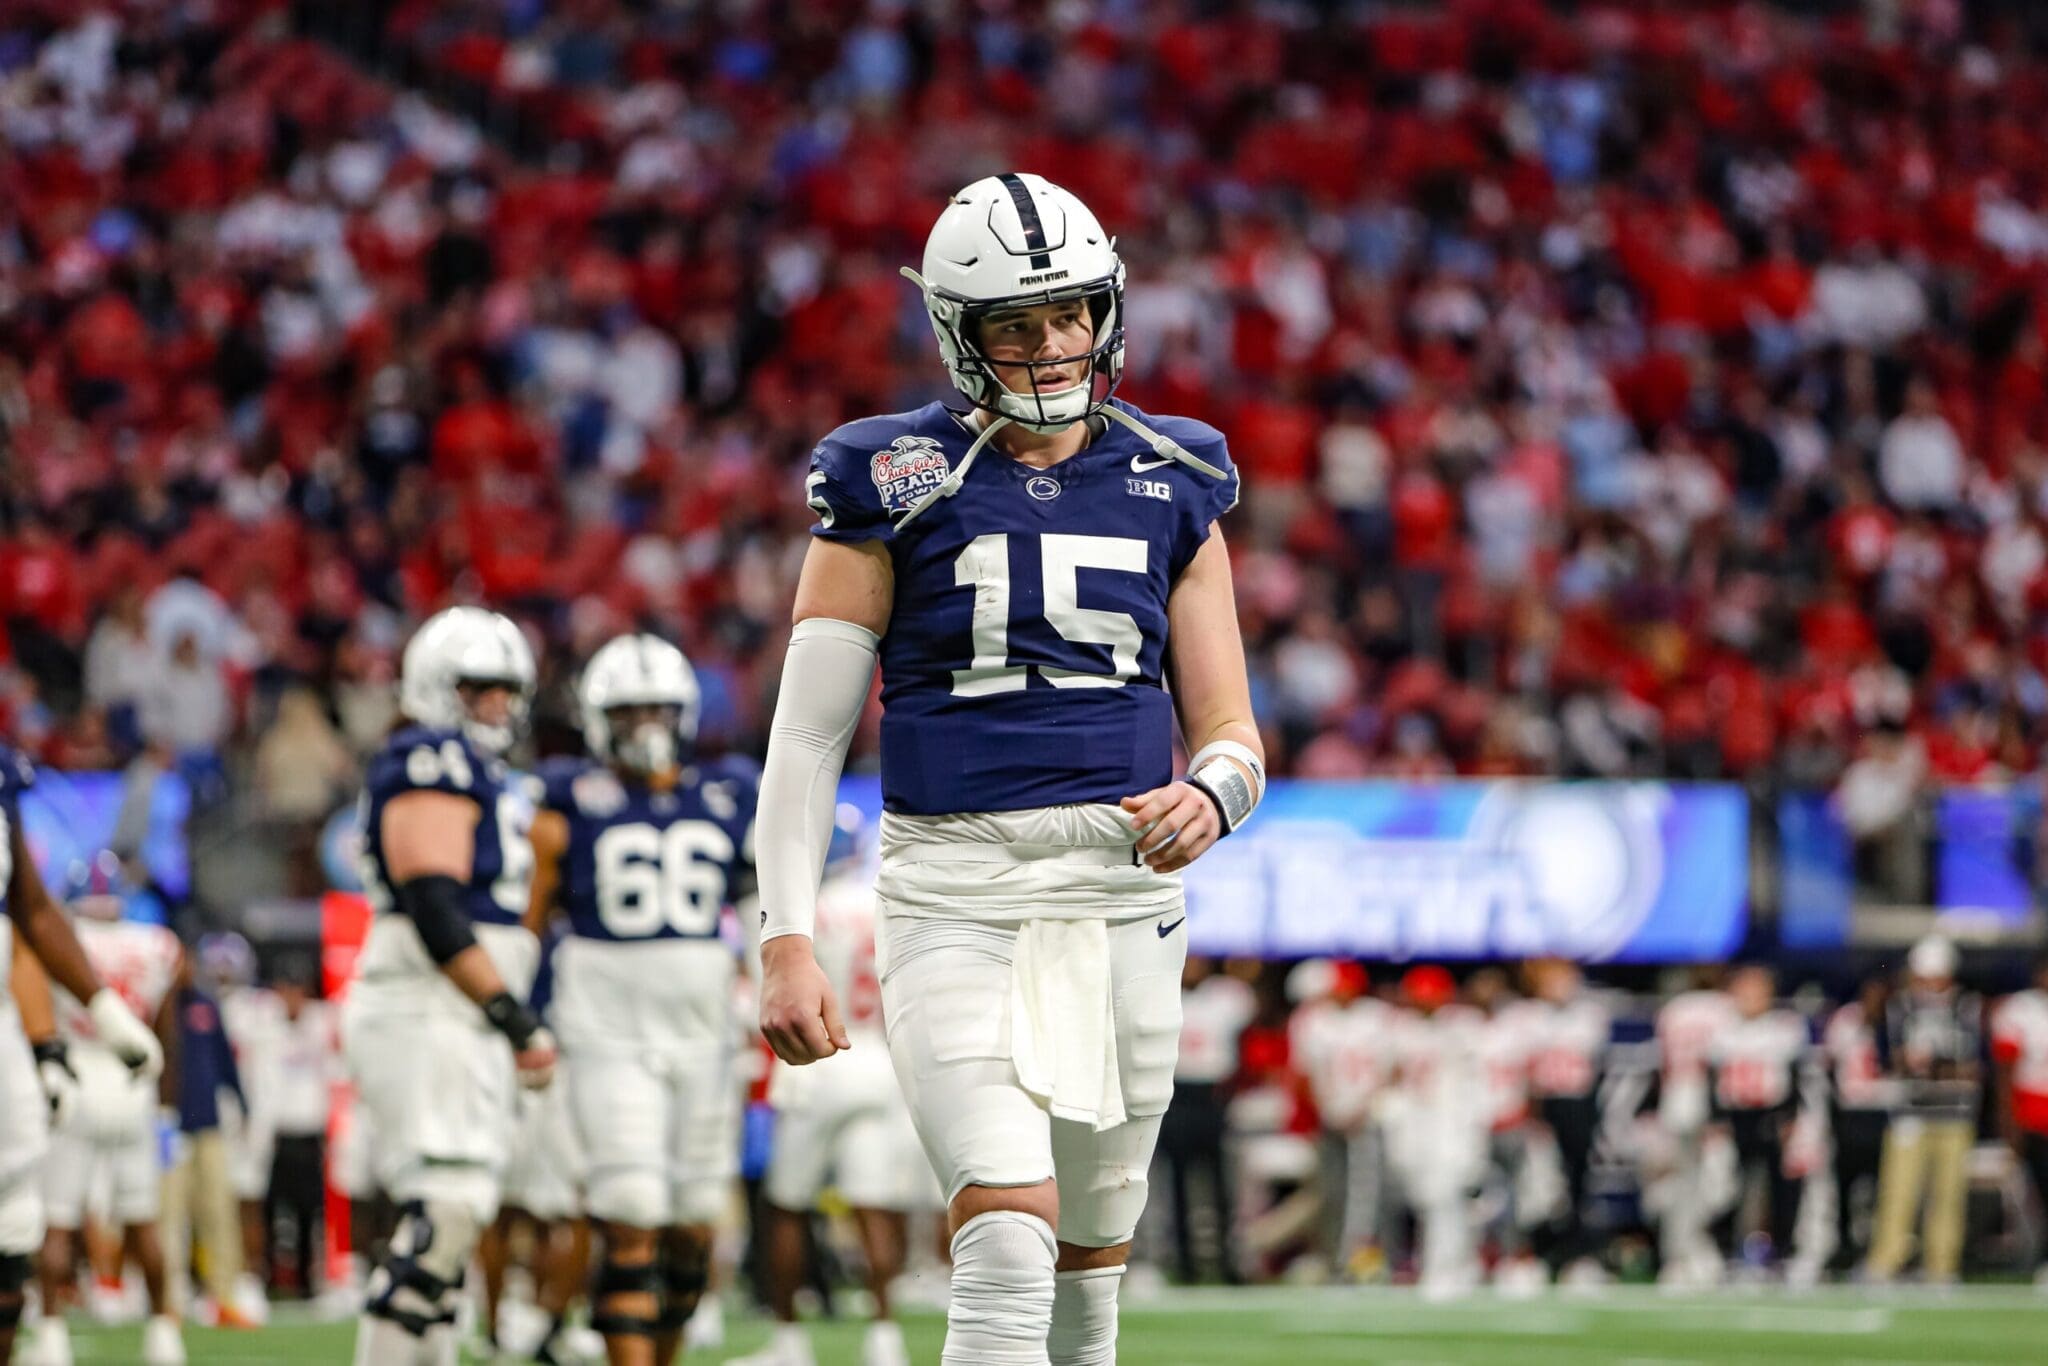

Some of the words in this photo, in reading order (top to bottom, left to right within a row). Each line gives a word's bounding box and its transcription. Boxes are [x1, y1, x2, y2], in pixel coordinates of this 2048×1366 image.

[1019, 275, 1043, 286] PENN
[1044, 270, 1069, 283] STATE
[881, 468, 946, 503] PEACH
[950, 533, 1148, 697] 15
[593, 820, 735, 938] 66
